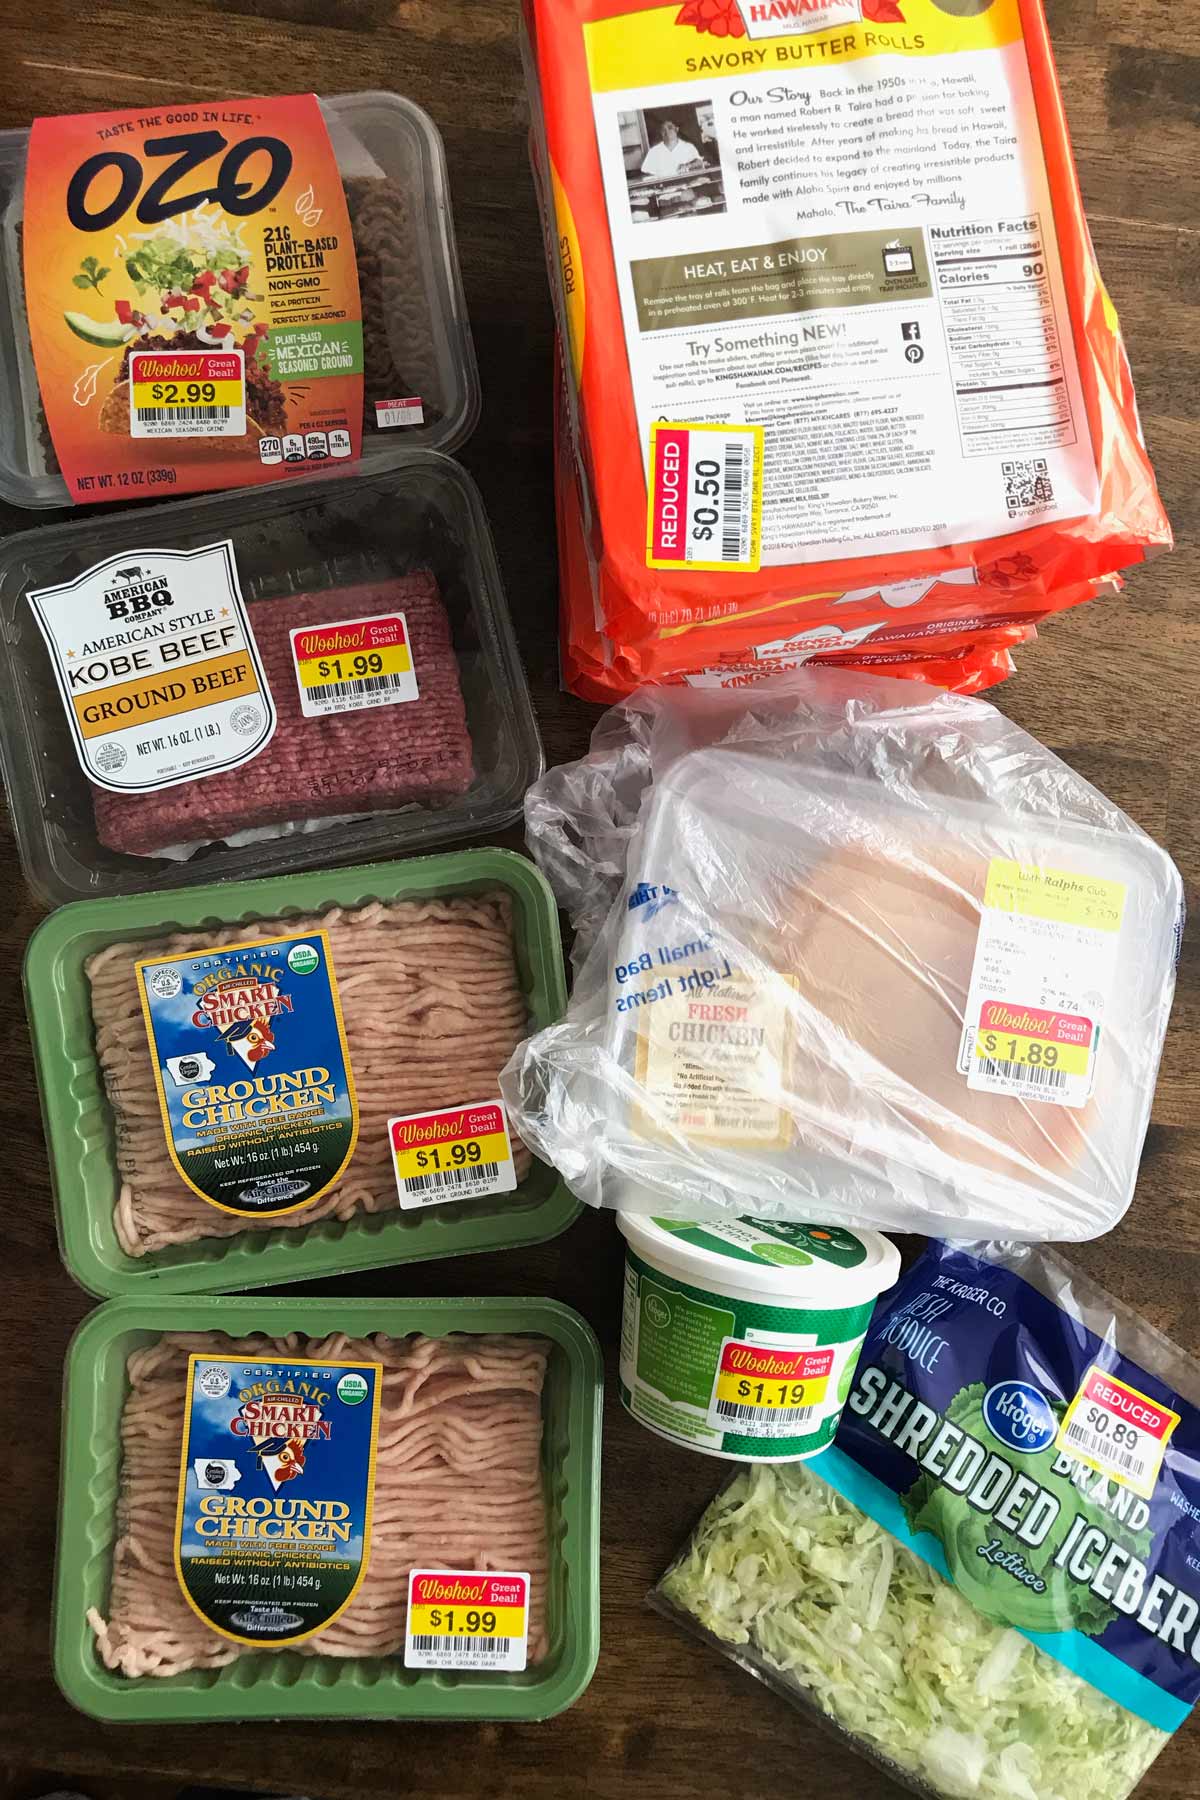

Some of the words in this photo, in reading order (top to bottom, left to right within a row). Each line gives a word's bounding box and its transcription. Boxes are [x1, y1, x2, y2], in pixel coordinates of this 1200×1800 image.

[686, 48, 767, 73] SAVORY
[776, 34, 857, 61] BUTTER
[864, 32, 925, 50] ROLLS
[729, 90, 764, 107] Our
[766, 86, 812, 106] Story
[819, 88, 843, 99] Back
[877, 77, 906, 92] 1950s
[96, 122, 135, 140] TASTE
[137, 116, 163, 129] THE
[166, 111, 199, 124] GOOD
[202, 111, 219, 122] IN
[222, 112, 254, 125] LIFE.
[67, 130, 293, 232] OZO
[835, 199, 866, 215] The
[867, 197, 911, 212] Taira
[912, 190, 966, 211] Family
[263, 226, 291, 242] 21G
[930, 224, 994, 239] Nutrition
[998, 219, 1037, 233] Facts
[264, 236, 338, 257] PLANT-BASED
[266, 252, 324, 272] PROTEIN
[560, 236, 575, 294] ROLLS
[684, 261, 728, 279] HEAT,
[731, 257, 760, 273] EAT
[763, 255, 775, 269] &
[779, 247, 828, 267] ENJOY
[1022, 263, 1044, 277] 90
[268, 277, 321, 291] NON-GMO
[939, 272, 990, 284] Calories
[287, 296, 321, 306] PROTEIN
[272, 314, 310, 325] PERFECTLY
[311, 310, 347, 320] SEASONED
[275, 331, 322, 345] PLANT-BASED
[686, 340, 710, 358] Try
[714, 330, 799, 353] Something
[803, 323, 847, 340] NEW!
[276, 342, 341, 360] MEXICAN
[138, 358, 204, 378] Woohoo!
[207, 359, 235, 369] Great
[208, 369, 234, 378] Deal!
[278, 359, 318, 374] SEASONED
[321, 355, 353, 370] GROUND
[152, 382, 216, 404] $2.99
[260, 439, 279, 452] 270
[77, 476, 95, 490] NET
[97, 474, 116, 489] WT.
[117, 473, 129, 486] 12
[131, 471, 144, 484] OZ
[146, 467, 177, 486] (339g)
[660, 442, 680, 548] REDUCED
[692, 460, 721, 541] $0.50
[104, 577, 168, 604] AMERICAN
[105, 589, 174, 620] BBQ
[124, 607, 163, 625] COMPANY
[82, 621, 166, 657] AMERICAN
[169, 609, 216, 632] STYLE
[300, 625, 366, 655] Woohoo!
[369, 624, 399, 636] Great
[372, 634, 397, 645] Deal!
[68, 649, 152, 688] KOBE
[159, 624, 236, 663] BEEF
[318, 653, 383, 680] $1.99
[83, 683, 186, 724] GROUND
[192, 665, 247, 695] BEEF
[136, 741, 152, 757] NET
[152, 738, 167, 754] WT.
[167, 735, 178, 750] 16
[179, 731, 194, 745] OZ.
[194, 727, 204, 744] (1
[204, 723, 221, 740] LB.)
[1044, 876, 1083, 895] Ralphs
[190, 949, 280, 970] CERTIFIED
[293, 950, 312, 960] USDA
[192, 963, 285, 997] ORGANIC
[201, 982, 276, 1012] SMART
[191, 994, 295, 1029] CHICKEN
[688, 1003, 749, 1023] FRESH
[986, 1005, 1056, 1035] Woohoo!
[668, 1022, 765, 1047] CHICKEN
[1056, 1029, 1083, 1042] Deal!
[1057, 1020, 1087, 1032] Great
[985, 1034, 997, 1051] $
[1006, 1038, 1059, 1067] 1.89
[181, 1066, 330, 1109] GROUND
[181, 1084, 337, 1129] CHICKEN
[468, 1111, 496, 1124] Great
[196, 1127, 228, 1138] MADE
[230, 1121, 256, 1132] WITH
[258, 1115, 286, 1126] FREE
[288, 1107, 325, 1121] RANGE
[214, 1129, 264, 1144] ORGANIC
[265, 1119, 312, 1134] CHICKEN
[398, 1114, 465, 1144] Woohoo!
[470, 1122, 496, 1133] Deal!
[186, 1144, 226, 1157] RAISED
[228, 1135, 275, 1150] WITHOUT
[278, 1122, 344, 1140] ANTIBIOTICS
[214, 1158, 231, 1170] Net
[230, 1155, 247, 1166] Wt.
[247, 1152, 258, 1163] 16
[294, 1141, 311, 1153] 454
[416, 1142, 482, 1169] $1.99
[899, 1291, 954, 1322] FRESH
[930, 1275, 950, 1292] THE
[950, 1281, 987, 1303] KROGER
[985, 1295, 1006, 1320] CO.
[875, 1316, 950, 1374] PRODUCE
[729, 1348, 803, 1375] Woohoo!
[802, 1365, 827, 1376] Deal!
[805, 1355, 830, 1366] Great
[243, 1368, 331, 1380] CERTIFIED
[343, 1380, 362, 1388] USDA
[237, 1380, 331, 1407] ORGANIC
[737, 1380, 805, 1404] $1.19
[1092, 1381, 1160, 1428] REDUCED
[244, 1401, 319, 1423] SMART
[994, 1391, 1049, 1445] Kroger
[229, 1417, 333, 1440] CHICKEN
[1086, 1406, 1138, 1450] $0.89
[848, 1365, 1062, 1551] SHREDDED
[1053, 1452, 1150, 1532] BRAND
[199, 1495, 350, 1521] GROUND
[194, 1516, 353, 1542] CHICKEN
[204, 1540, 237, 1548] MADE
[240, 1541, 267, 1549] WITH
[269, 1542, 297, 1550] FREE
[299, 1543, 336, 1552] RANGE
[222, 1550, 271, 1558] ORGANIC
[273, 1551, 321, 1560] CHICKEN
[190, 1557, 231, 1566] RAISED
[234, 1559, 282, 1568] WITHOUT
[283, 1561, 350, 1571] ANTIBIOTICS
[977, 1538, 1047, 1592] Lettuce
[214, 1573, 231, 1584] Net
[231, 1573, 248, 1585] Wt.
[248, 1574, 260, 1585] 16
[296, 1575, 314, 1587] 454
[418, 1578, 488, 1601] Woohoo!
[490, 1582, 520, 1593] Great
[490, 1593, 518, 1603] Deal!
[430, 1609, 497, 1633] $1.99
